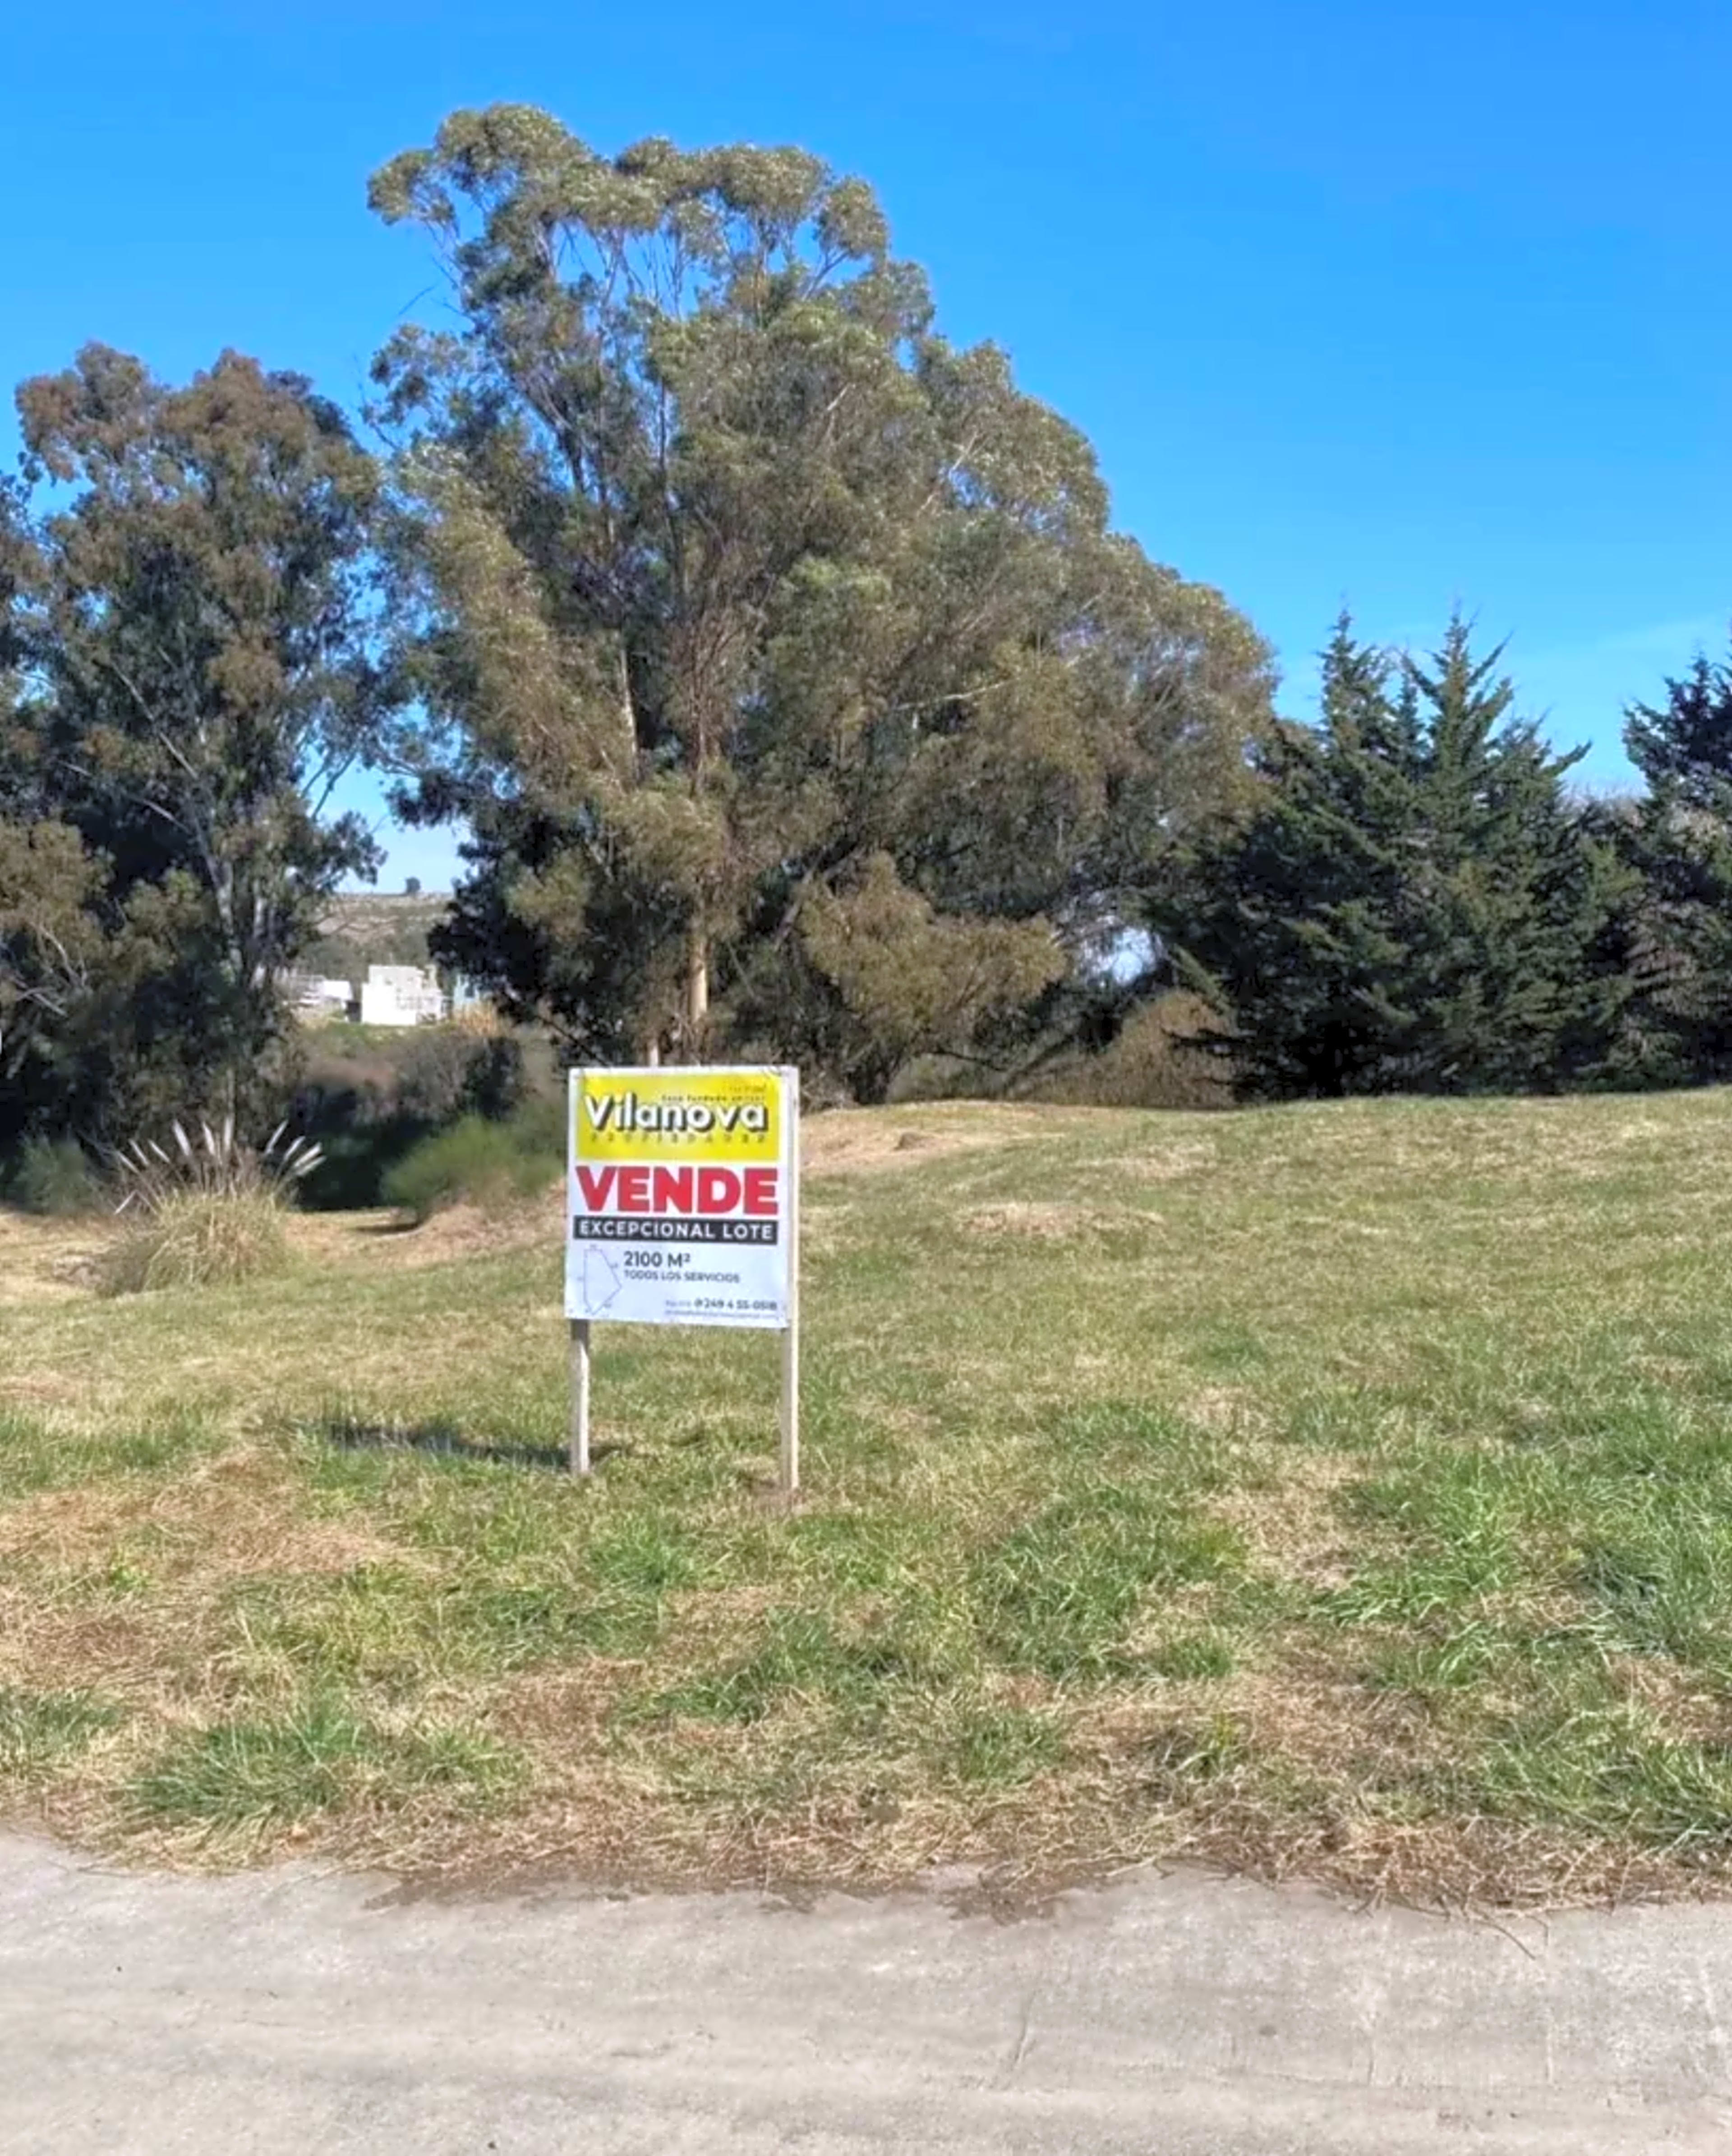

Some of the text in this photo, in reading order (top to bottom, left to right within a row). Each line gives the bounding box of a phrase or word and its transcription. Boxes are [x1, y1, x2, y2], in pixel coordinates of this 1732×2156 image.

[585, 1092, 769, 1132] Vilanova
[576, 1166, 778, 1215] VENDE
[580, 1221, 773, 1240] EXCEPCIONAL LOTE
[623, 1250, 663, 1268] 2100
[624, 1270, 740, 1283] TODOS LOS SERVICIOS
